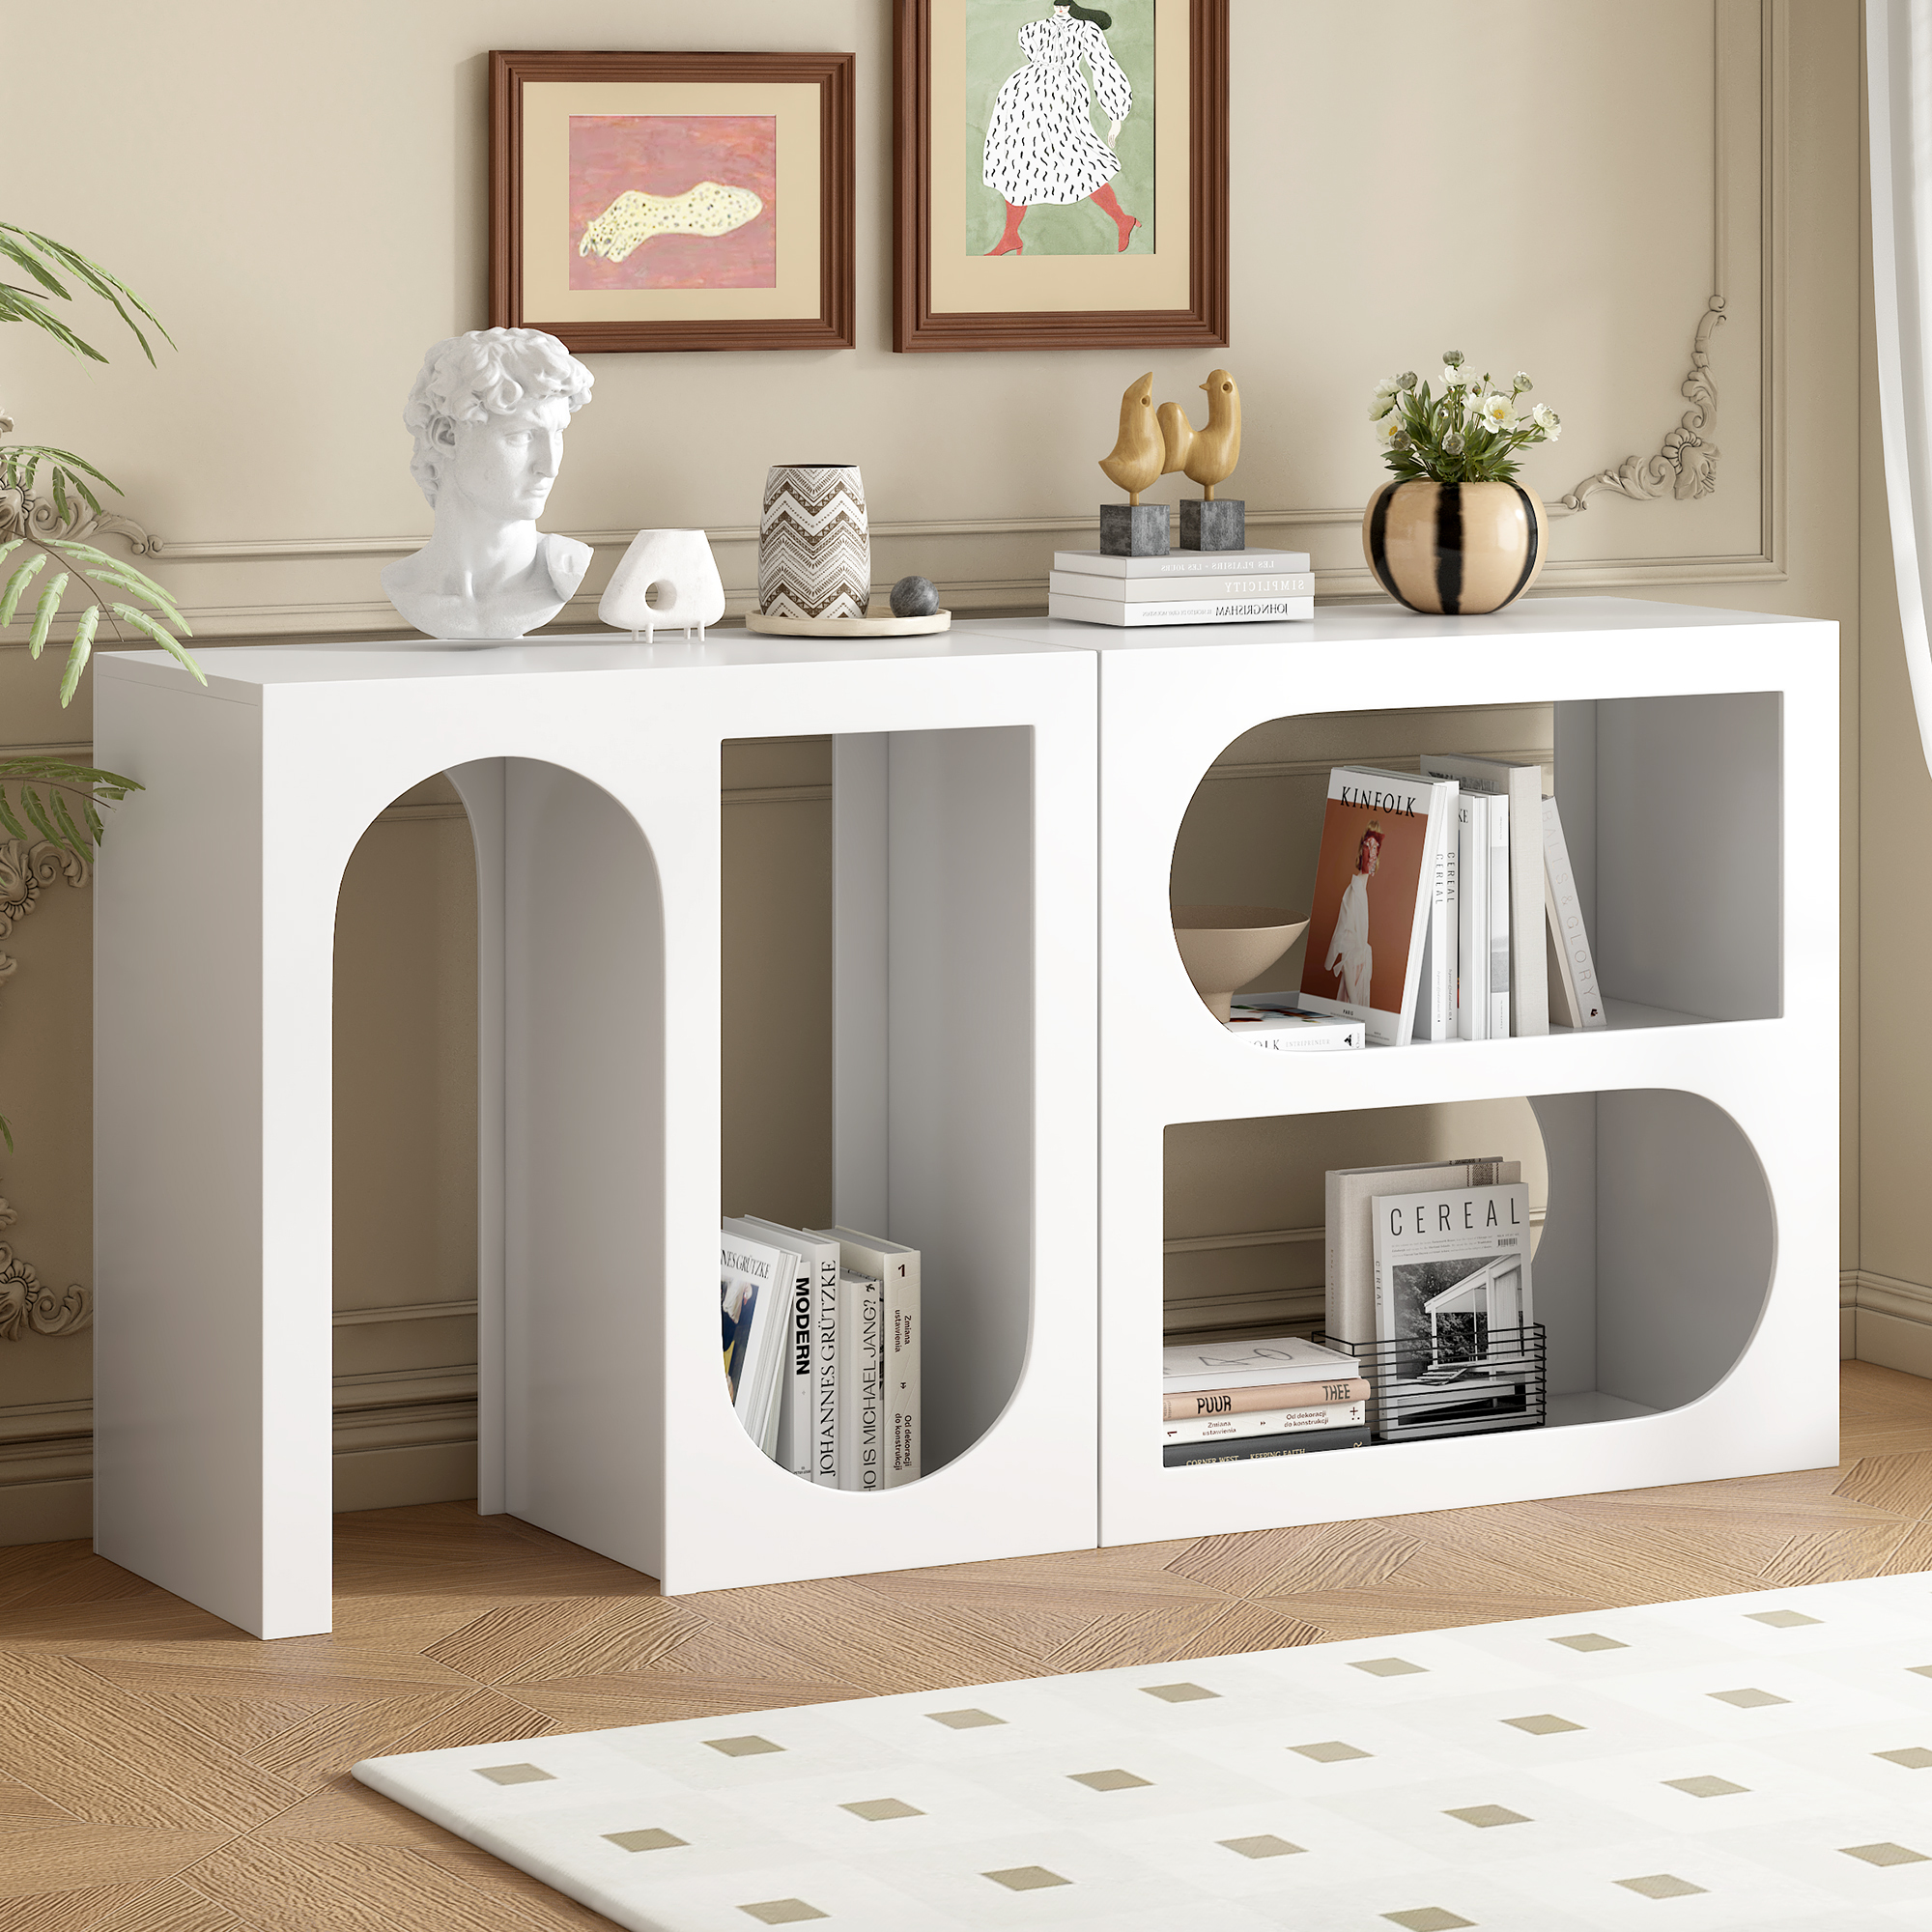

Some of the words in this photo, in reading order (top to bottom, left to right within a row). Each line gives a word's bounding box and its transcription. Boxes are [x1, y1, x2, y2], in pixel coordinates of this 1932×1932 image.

[1340, 785, 1416, 818] KINFOLK
[1435, 853, 1444, 905] CEREAL
[1447, 852, 1456, 903] CEREAL
[1566, 916, 1597, 996] GLORY
[1286, 1039, 1330, 1048] ENTREPRENEUR
[1390, 1197, 1520, 1236] CEREAL
[897, 1264, 906, 1278] 1
[795, 1277, 810, 1376] MODERN
[818, 1260, 837, 1362] GRÜTZKE
[863, 1299, 877, 1358] JANG?
[863, 1365, 877, 1445] MICHAEL
[895, 1412, 902, 1424] do
[1196, 1395, 1233, 1414] PUUR
[1321, 1383, 1351, 1402] THEE
[1296, 1410, 1327, 1420] dekoracji
[820, 1365, 836, 1477] JOHANNES
[904, 1414, 912, 1426] Od
[1202, 1427, 1236, 1436] ustawienia
[1293, 1417, 1329, 1428] konstrukcji
[863, 1448, 877, 1466] IS
[895, 1426, 903, 1471] konstrukcji
[904, 1428, 913, 1467] dekoracji
